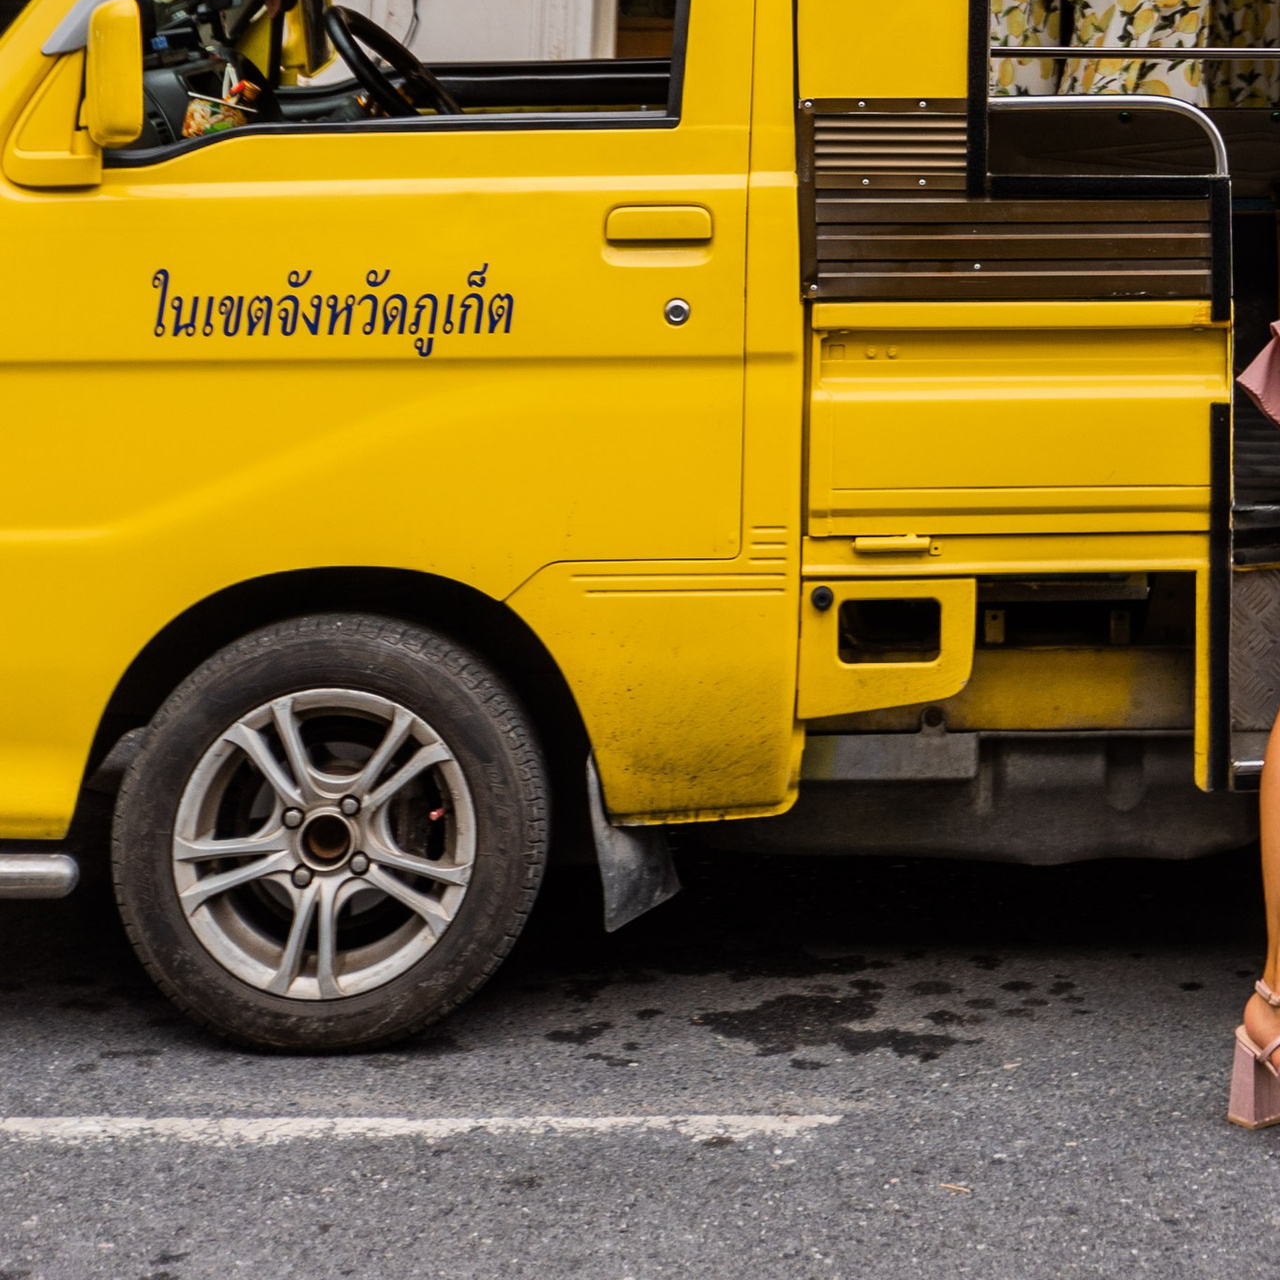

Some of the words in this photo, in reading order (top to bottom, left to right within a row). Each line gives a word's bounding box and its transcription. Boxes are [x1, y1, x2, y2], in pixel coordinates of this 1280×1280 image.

[151, 263, 516, 358] ในเขตจังหวัดภูเก็ต
